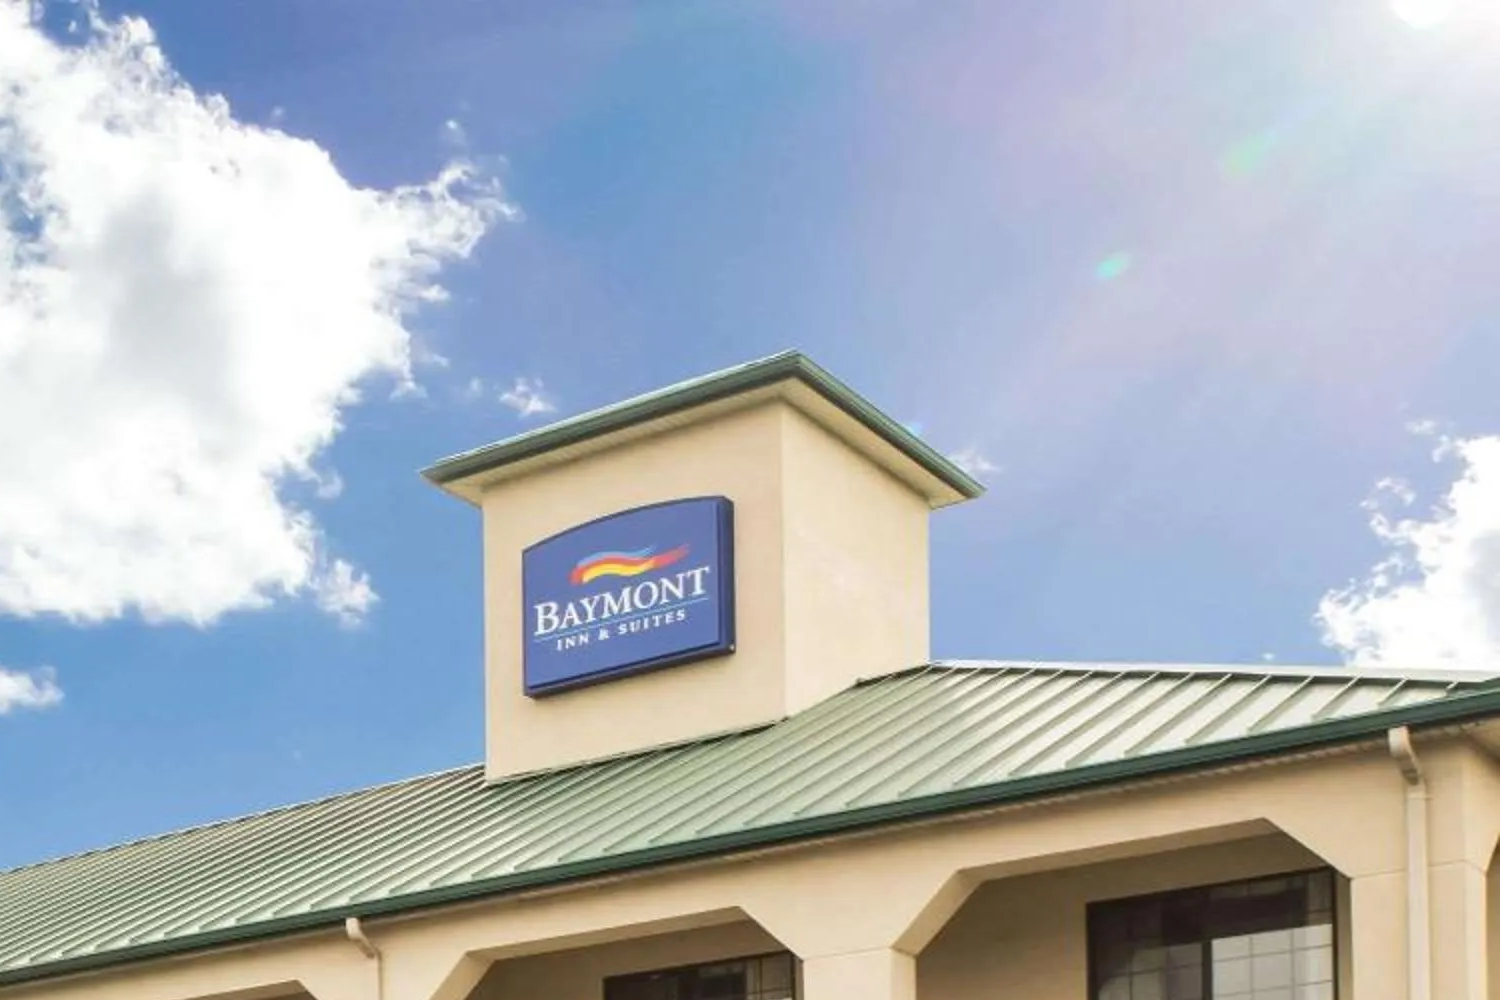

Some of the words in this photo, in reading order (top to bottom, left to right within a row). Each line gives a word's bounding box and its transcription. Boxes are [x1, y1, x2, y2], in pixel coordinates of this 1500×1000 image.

[533, 566, 709, 636] BAYMONT
[556, 632, 590, 651] INN
[598, 628, 610, 641] &
[618, 609, 686, 635] SUITES
